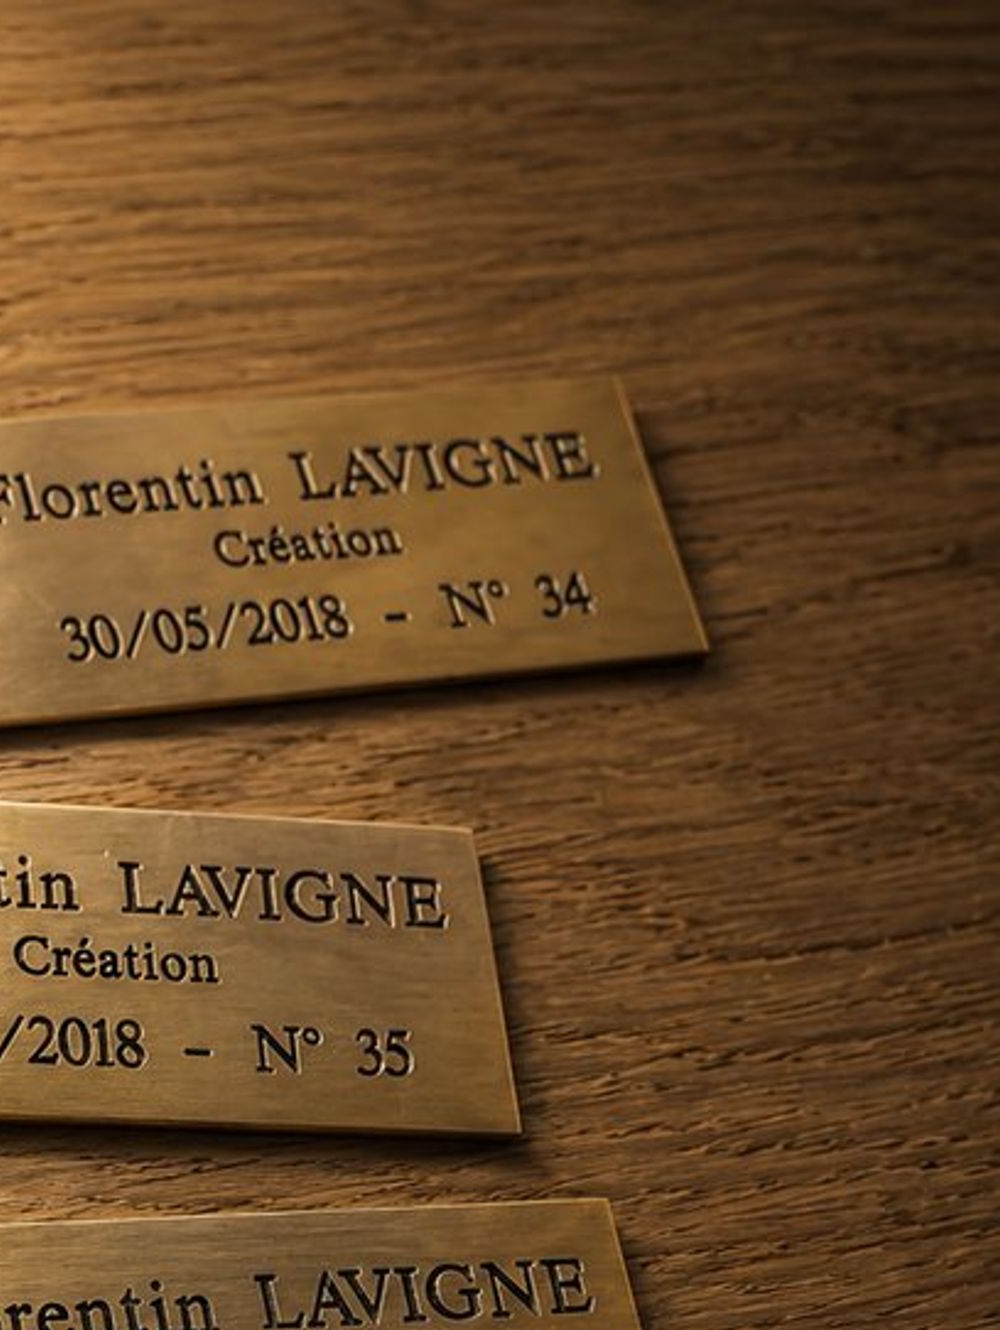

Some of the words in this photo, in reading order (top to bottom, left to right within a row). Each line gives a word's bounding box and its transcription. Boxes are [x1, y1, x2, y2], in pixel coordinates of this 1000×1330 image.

[292, 432, 598, 502] LAVIGNE
[213, 521, 404, 570] Création
[59, 594, 350, 664] 30/05/2018
[537, 571, 595, 619] 34
[120, 859, 450, 930] LAVIGNE
[12, 934, 220, 985] Création
[357, 1029, 414, 1079] 35
[257, 1257, 595, 1330] LAVIGNE
